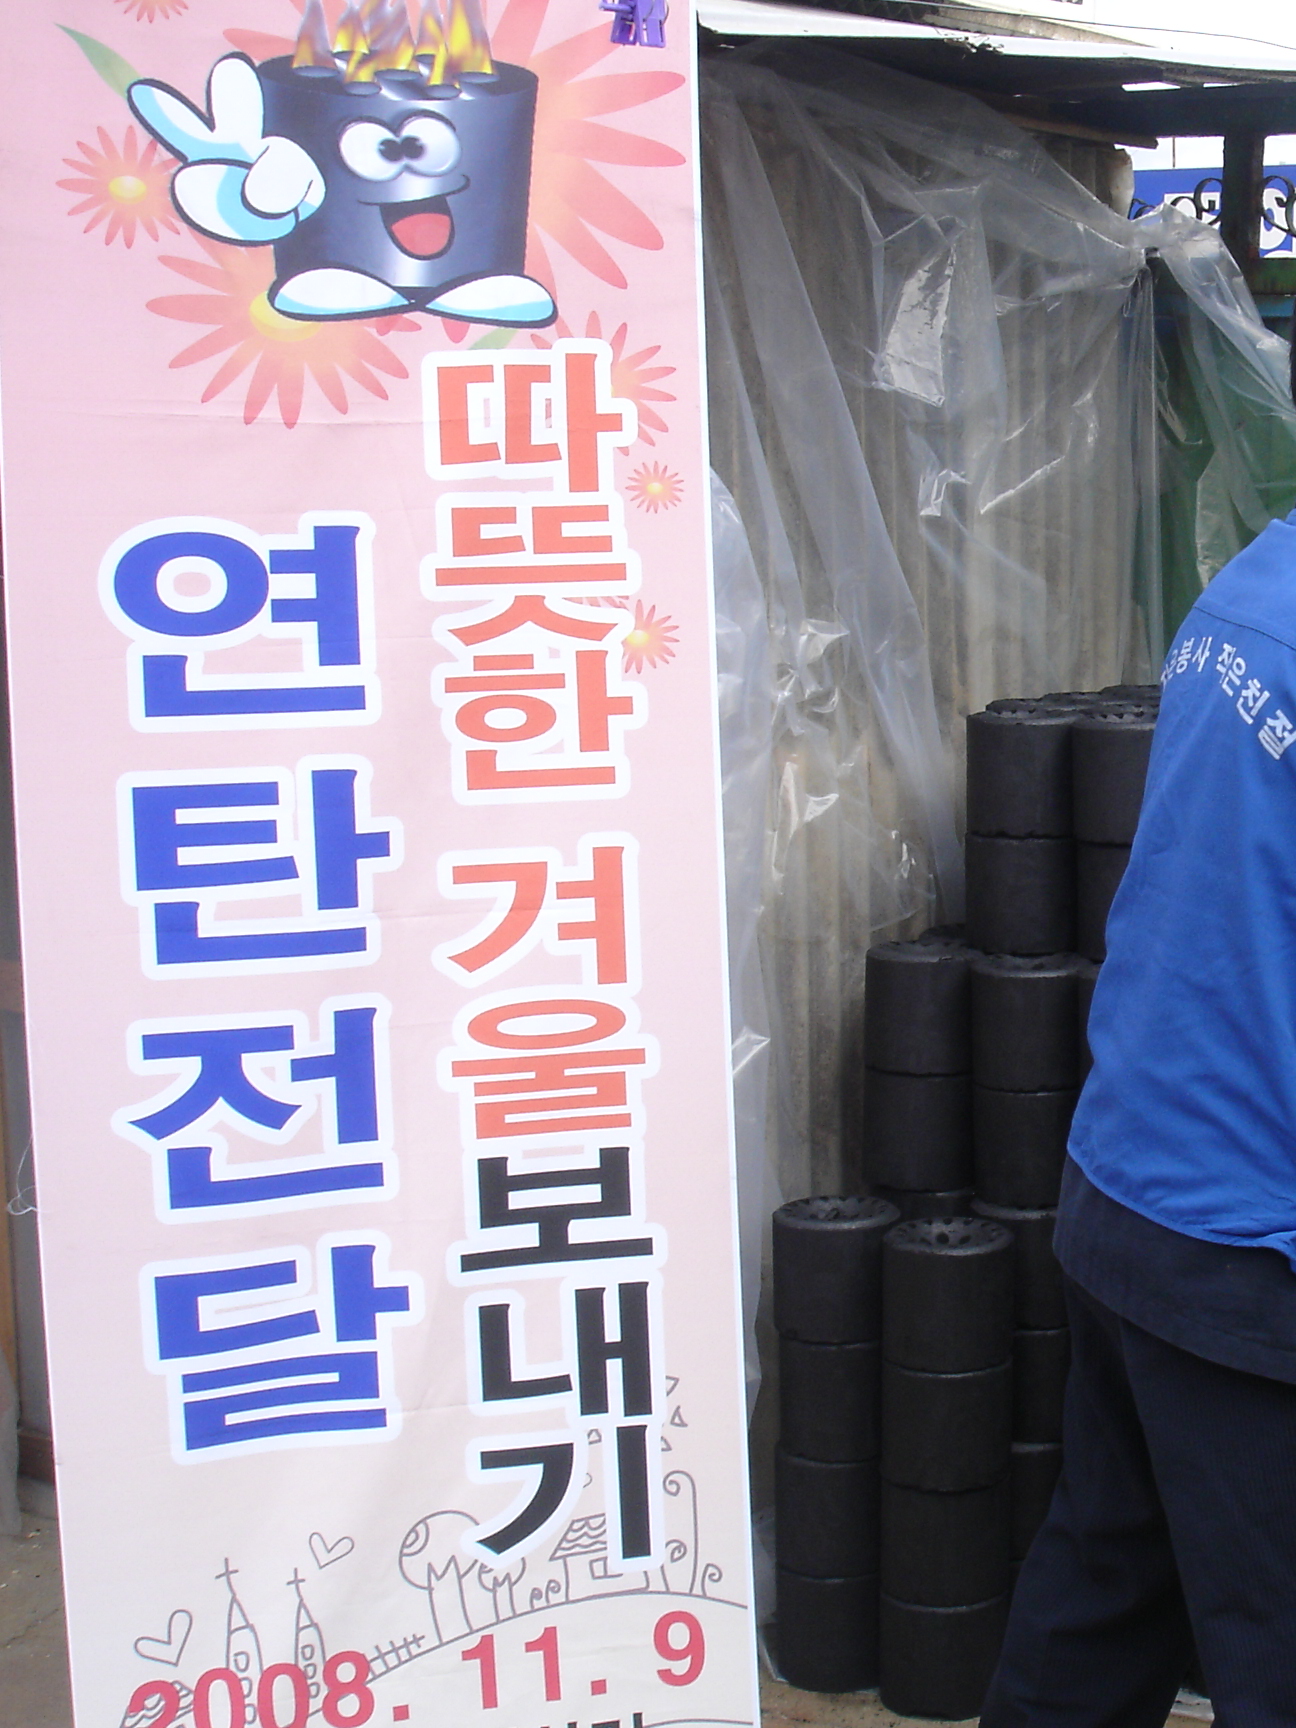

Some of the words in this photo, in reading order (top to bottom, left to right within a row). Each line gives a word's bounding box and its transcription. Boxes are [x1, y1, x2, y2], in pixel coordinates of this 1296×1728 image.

[435, 353, 635, 791] 따뜻한
[113, 525, 410, 1451] 연탄전달
[462, 1626, 607, 1708] 11.
[653, 1610, 706, 1686] 9
